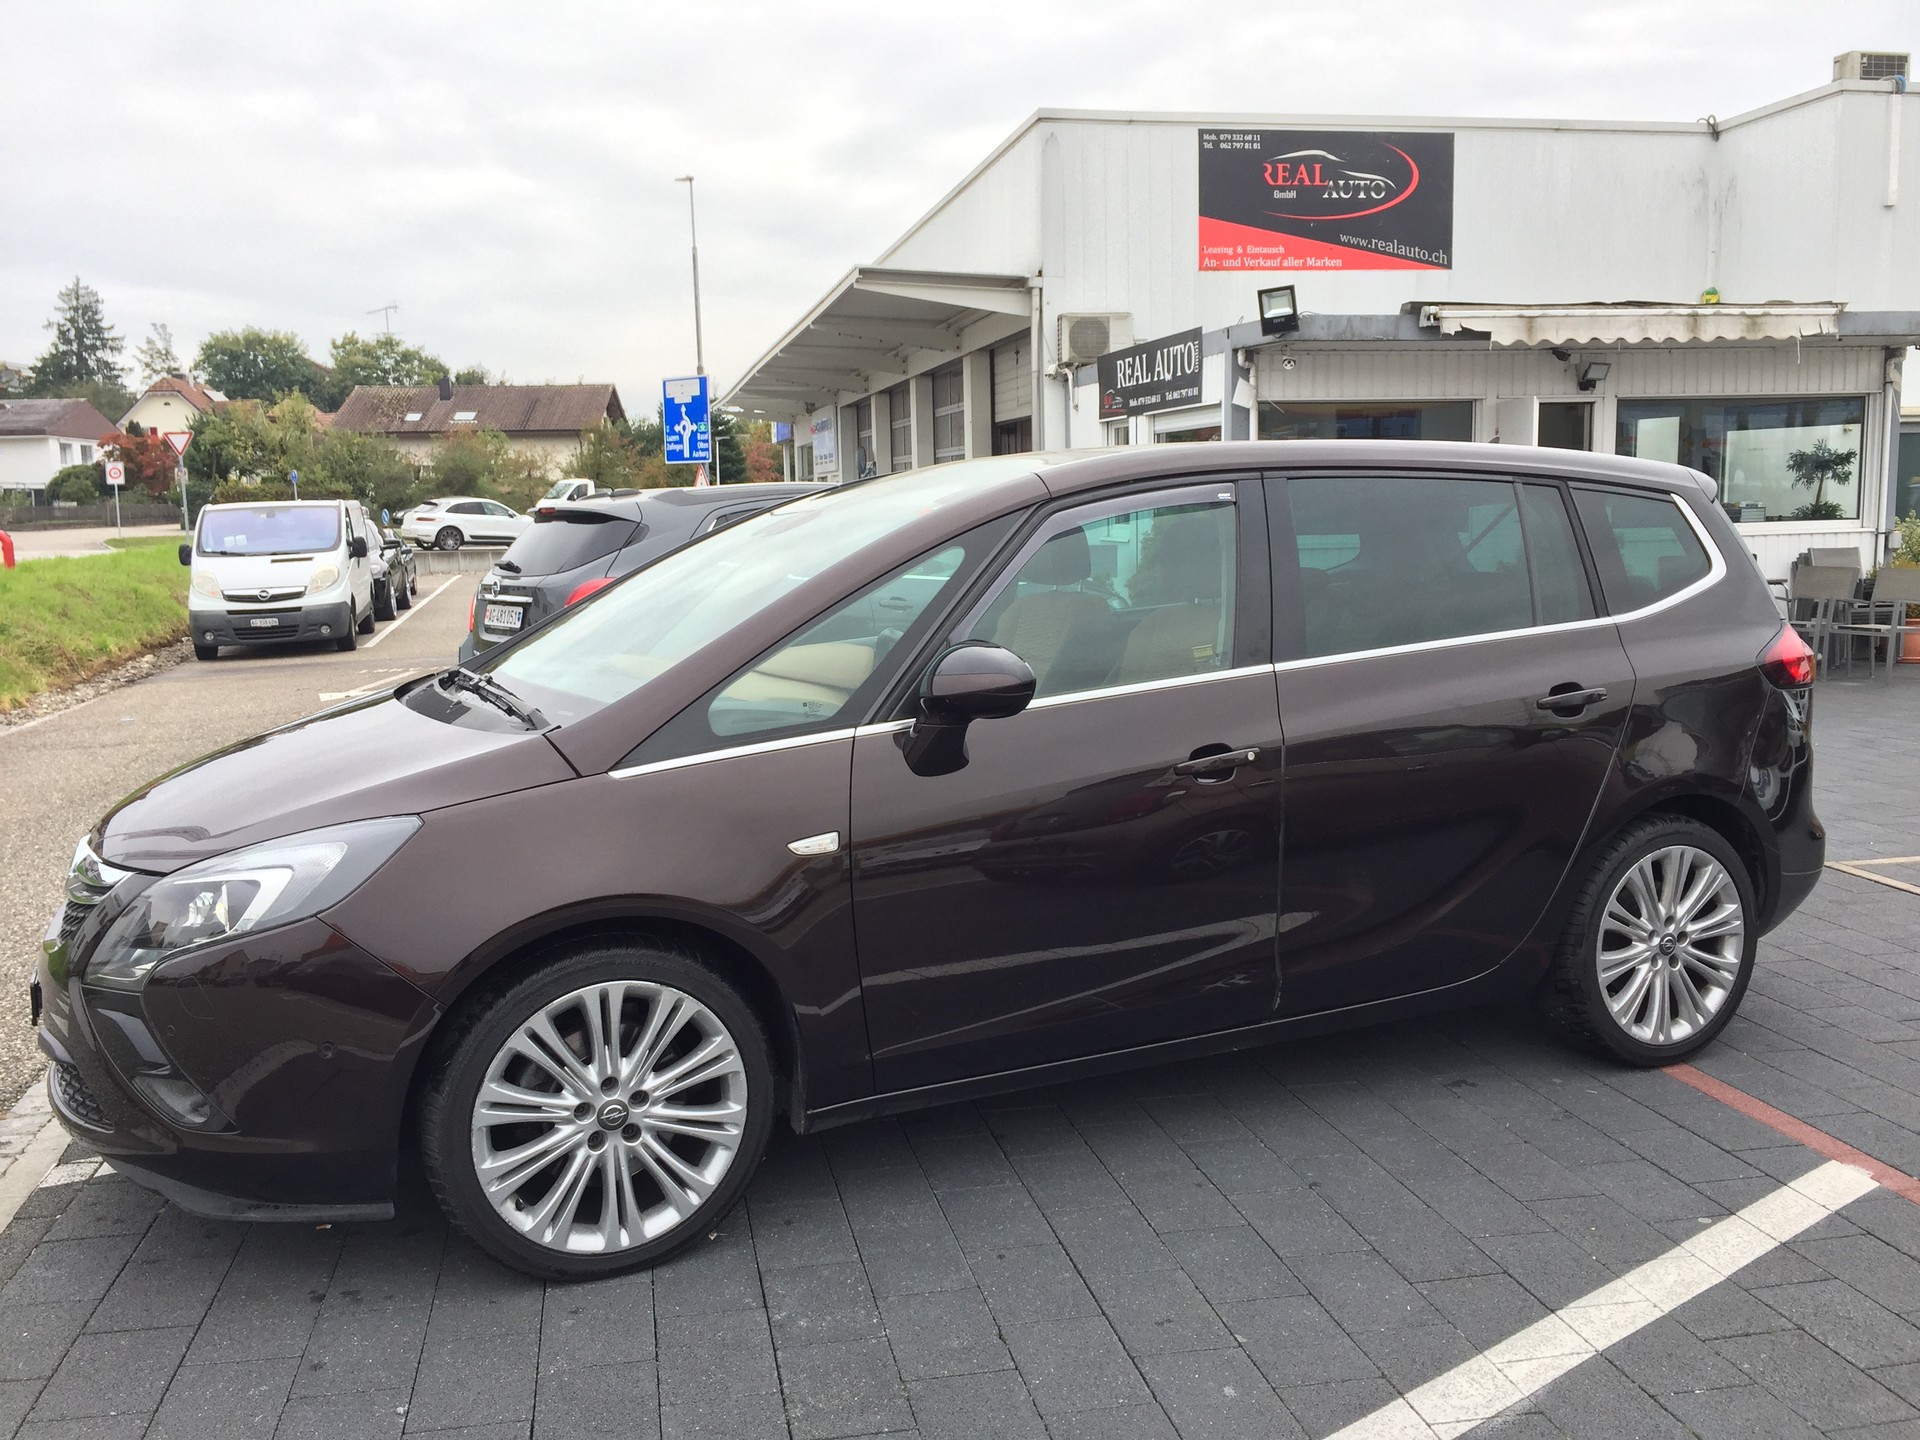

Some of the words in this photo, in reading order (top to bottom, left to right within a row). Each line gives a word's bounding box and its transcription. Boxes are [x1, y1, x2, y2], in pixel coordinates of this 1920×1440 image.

[1263, 163, 1329, 186] REAL
[1273, 189, 1297, 199] GmbH
[1322, 180, 1387, 199] AUTO
[1203, 245, 1233, 255] Leasing
[1236, 245, 1243, 254] &
[1247, 245, 1285, 254] Eintausch
[1339, 233, 1448, 265] www.realauto.ch
[1203, 257, 1220, 267] An-
[1223, 257, 1241, 267] und
[1244, 257, 1282, 267] Verkauf
[1282, 257, 1304, 267] aller
[1306, 257, 1342, 267] Marken
[1116, 353, 1151, 389] REAL
[1153, 341, 1195, 381] AUTO
